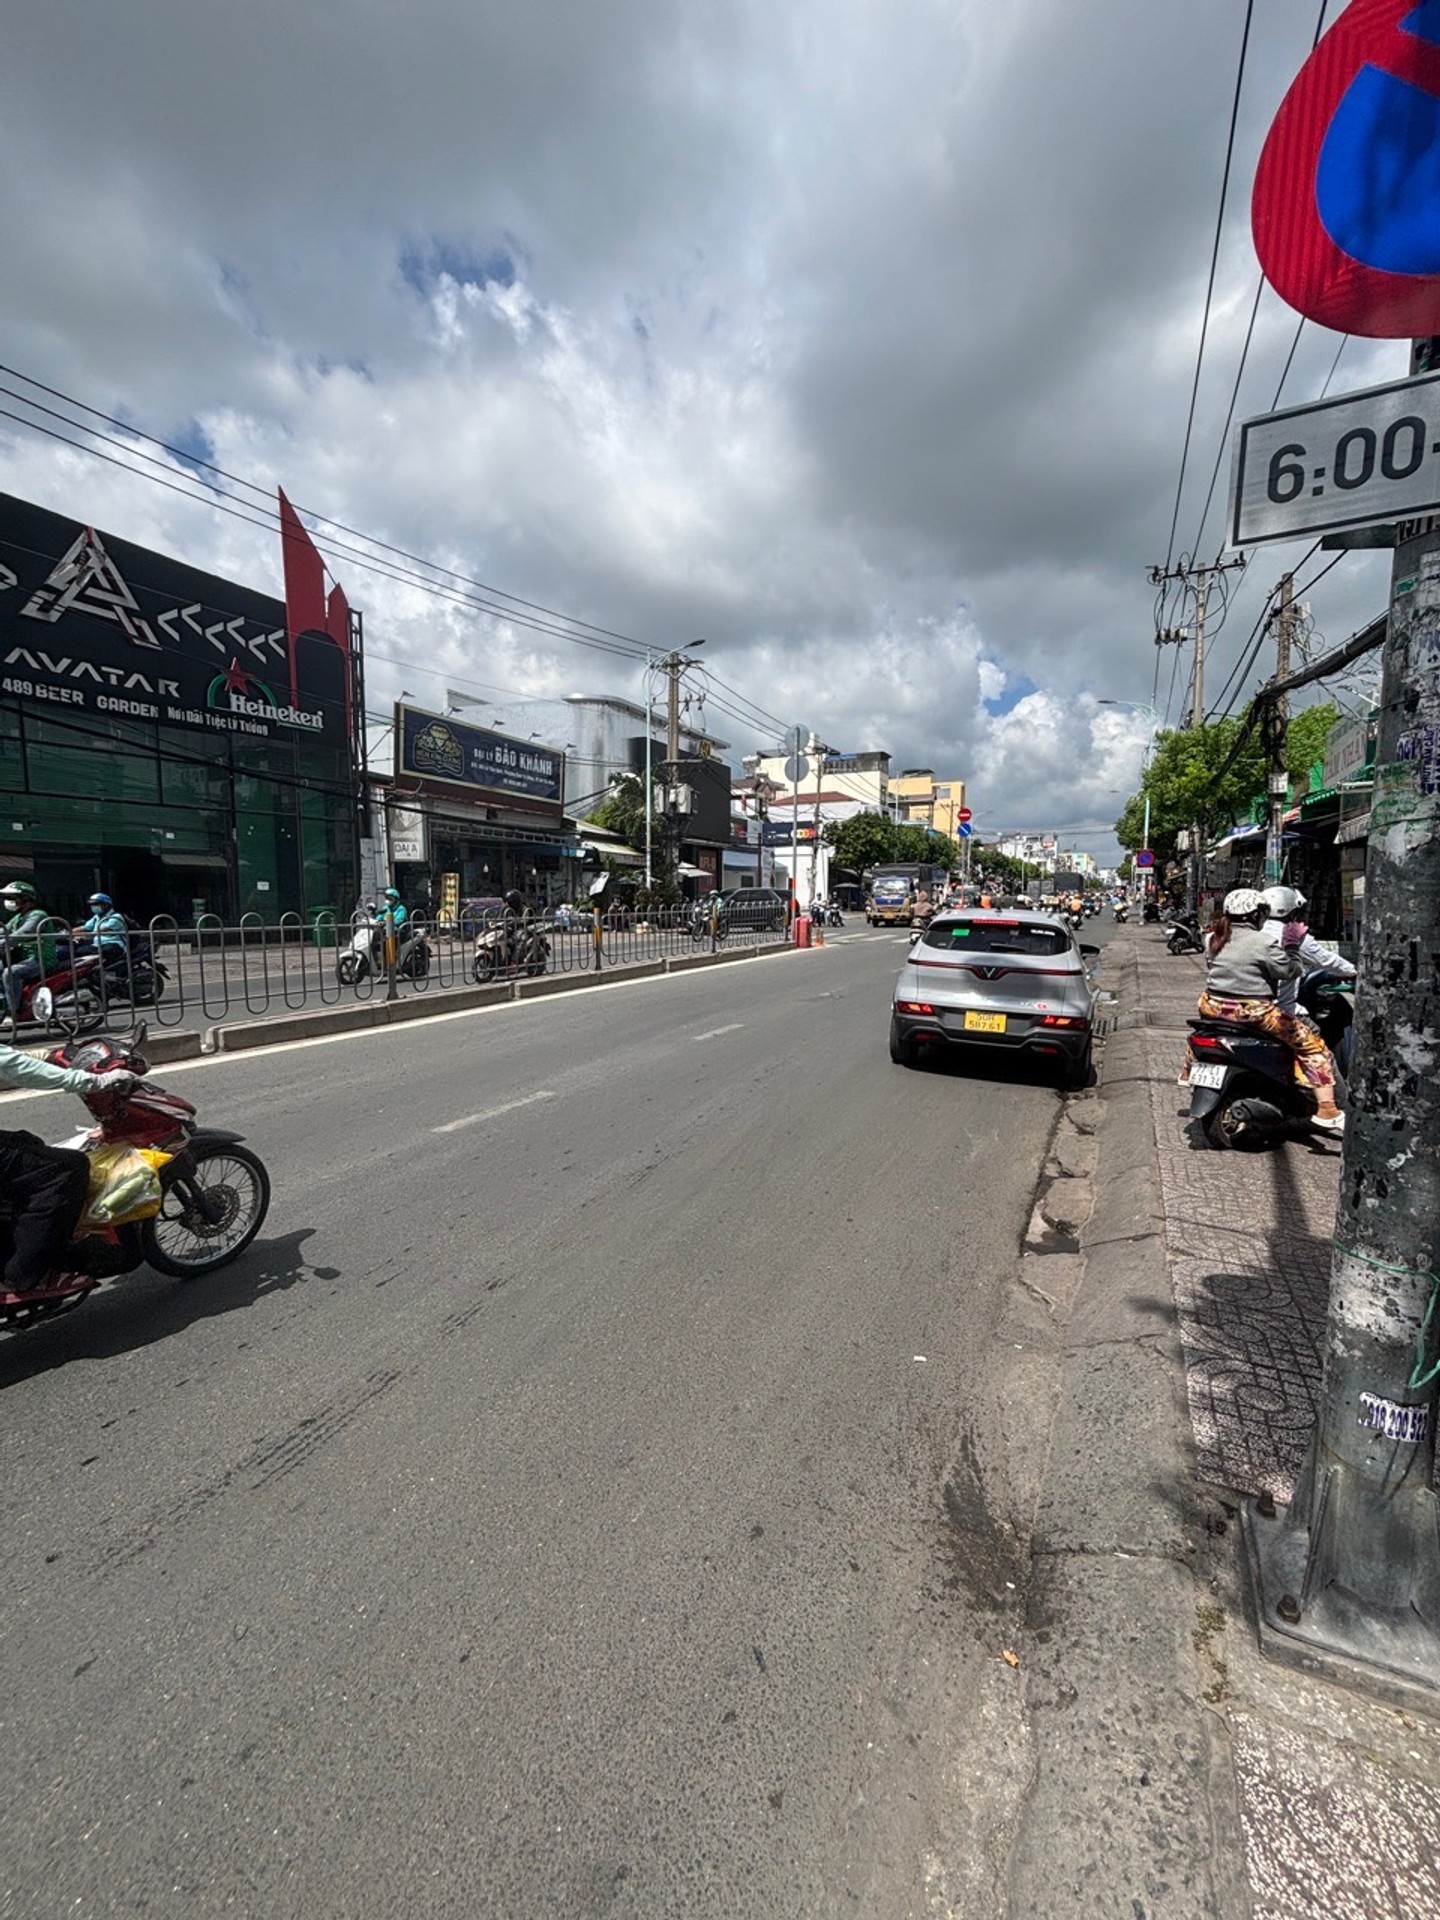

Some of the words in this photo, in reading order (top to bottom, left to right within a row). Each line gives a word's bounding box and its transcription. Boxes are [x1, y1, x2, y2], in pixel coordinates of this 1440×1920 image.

[4, 646, 181, 698] AVATAR
[2, 677, 33, 696] 489
[35, 683, 85, 706] BEER
[96, 695, 159, 718] GARDEN
[230, 692, 324, 729] Heineken
[495, 743, 517, 767] BẢO
[519, 752, 552, 776] KHÁNH
